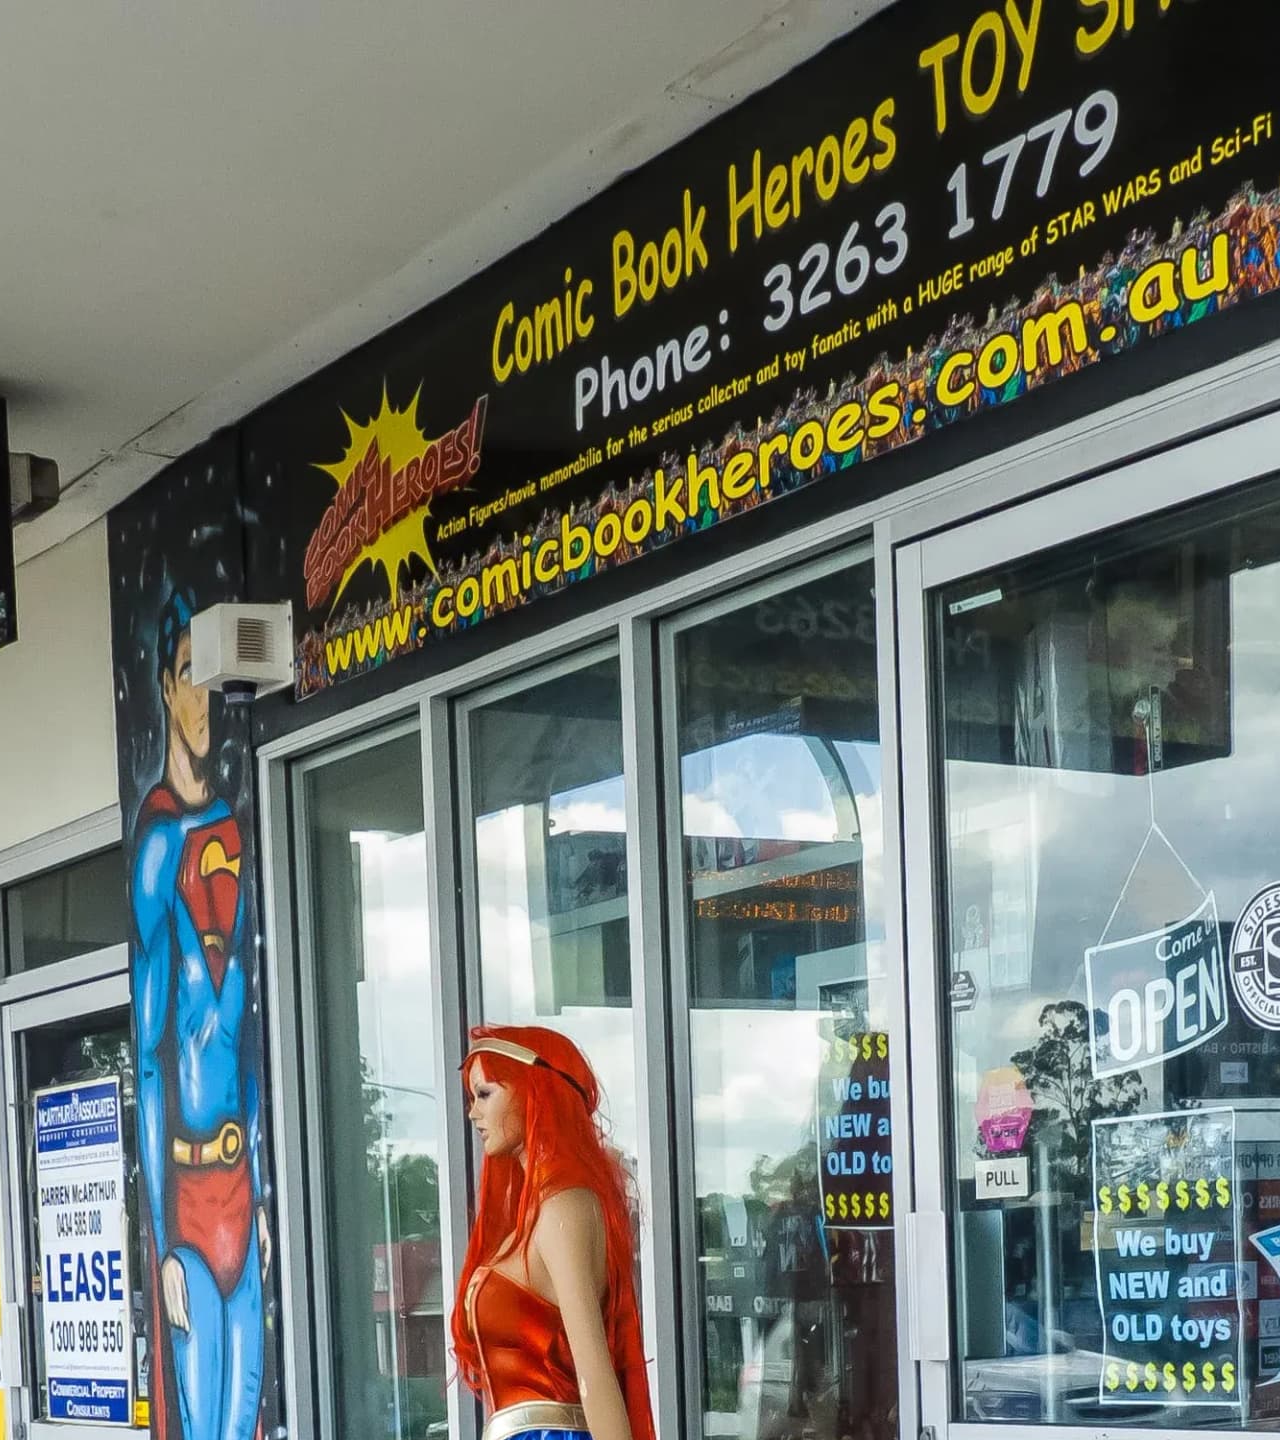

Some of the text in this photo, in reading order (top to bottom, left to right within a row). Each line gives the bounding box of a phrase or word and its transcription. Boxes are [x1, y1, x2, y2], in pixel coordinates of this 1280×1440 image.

[491, 266, 595, 384] Comic
[612, 188, 708, 320] Book
[728, 97, 897, 252] Heroes
[919, 0, 1042, 134] TOY
[575, 89, 1119, 431] Phone: 3263 1779
[436, 111, 1273, 542] Action Figures/movie memorabilia for the serious collector and toy fanatic with a HUGE range of STAR WARS and Sci-Fi
[325, 232, 1230, 676] www.comicbookheroes.com.au
[1155, 925, 1203, 961] Come
[1240, 954, 1257, 968] EST.
[1108, 946, 1221, 1062] OPEN
[1242, 975, 1280, 1016] OFFICIAL
[832, 1075, 890, 1101] We bu
[77, 1096, 116, 1121] ASSOCIATES
[825, 1113, 872, 1140] NEW
[827, 1150, 893, 1176] OLD to
[985, 1170, 1020, 1187] PULL
[41, 1180, 117, 1207] DARREN McARTHUR
[1115, 1228, 1216, 1262] We buy
[46, 1250, 124, 1303] LEASE
[1108, 1268, 1228, 1300] NEW and
[49, 1320, 124, 1353] 1300 989 550
[1112, 1314, 1163, 1342] OLD
[1170, 1314, 1232, 1349] toys
[50, 1380, 125, 1399] COMMERCIAL PROPERTY
[66, 1399, 111, 1419] CONSULTANTS
